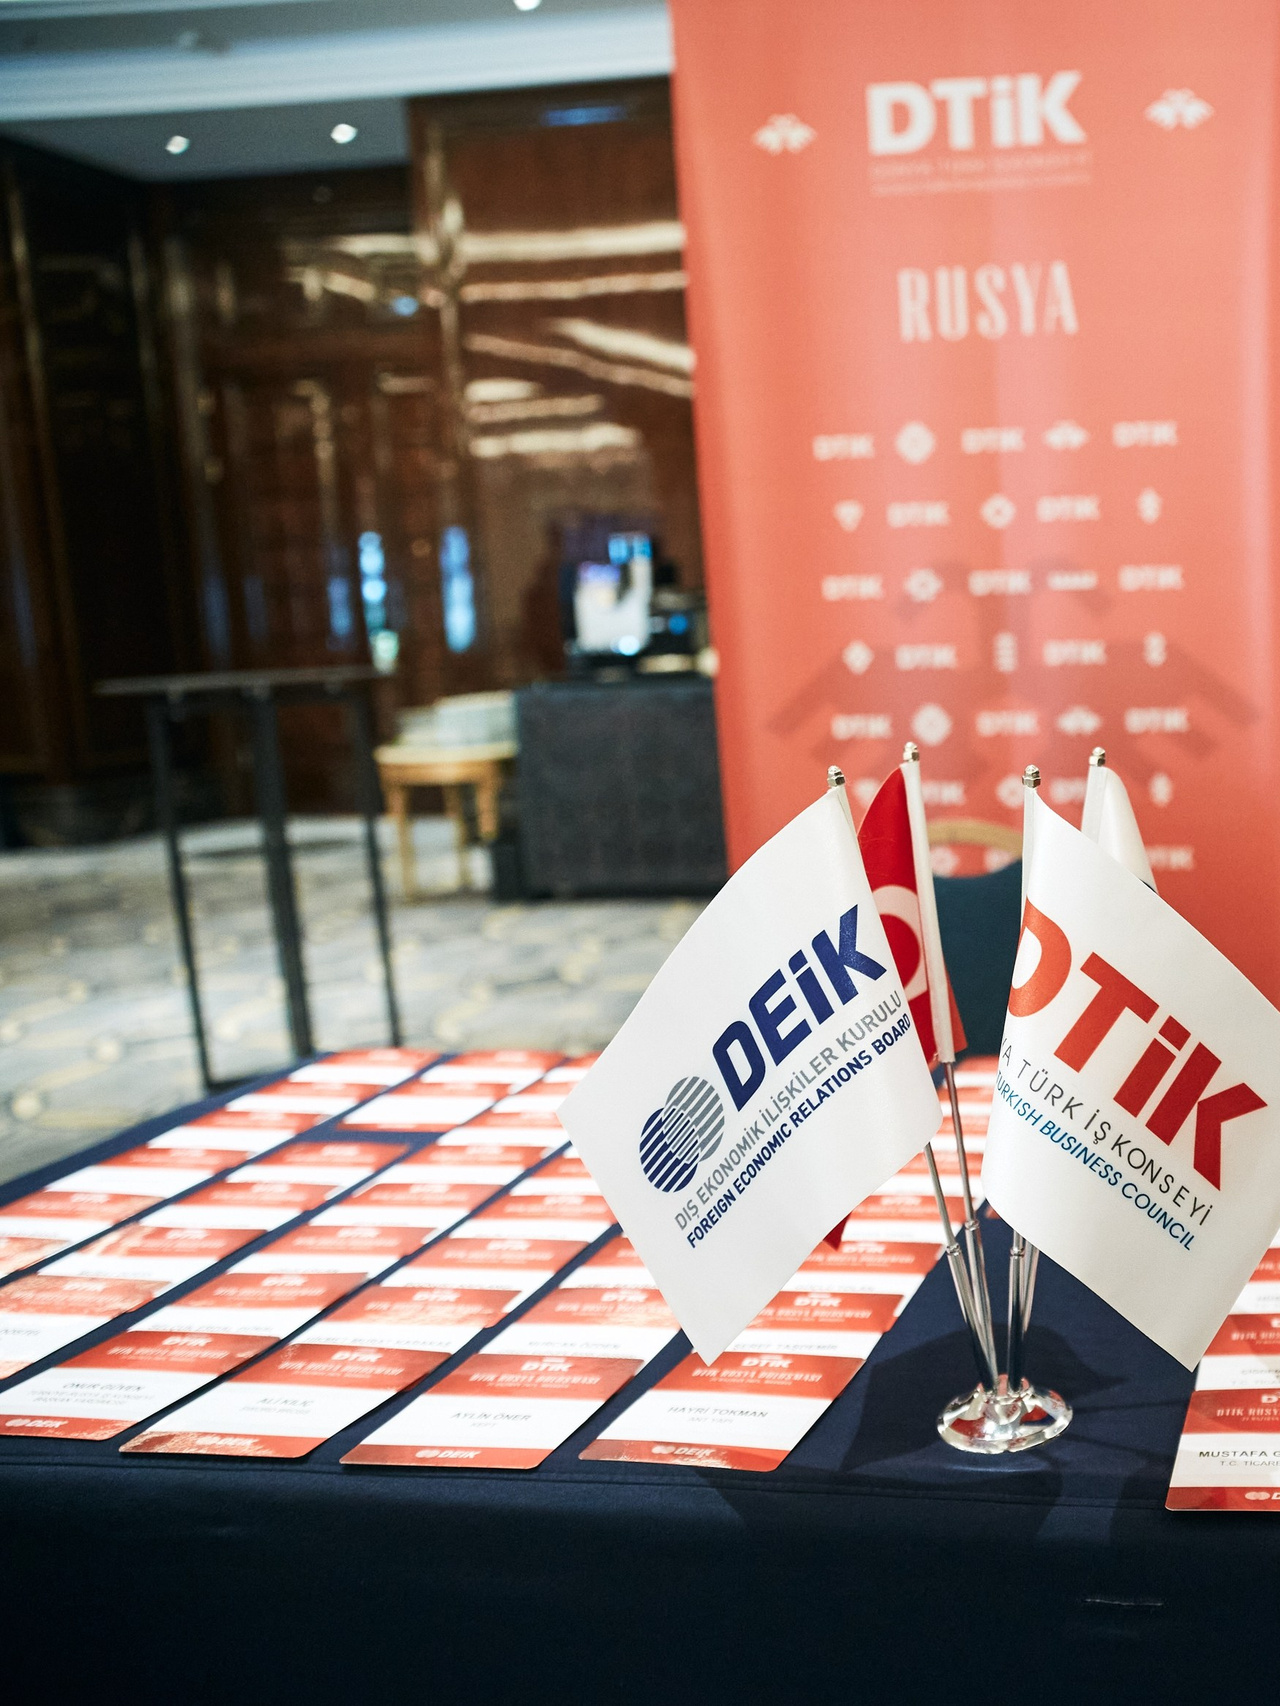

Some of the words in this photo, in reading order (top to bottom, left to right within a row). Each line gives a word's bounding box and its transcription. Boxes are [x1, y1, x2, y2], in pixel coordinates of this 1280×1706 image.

[897, 260, 1078, 343] RUSYA
[674, 1199, 699, 1231] DIŞ
[698, 1124, 766, 1206] EKONOMİK
[761, 1046, 839, 1131] İLİŞKİLER
[836, 990, 902, 1056] KURULU
[686, 1188, 737, 1249] FOREIGN
[733, 1121, 793, 1194] ECONOMIC
[789, 1048, 872, 1128] RELATIONS
[870, 1012, 911, 1058] BOARD
[1017, 1058, 1084, 1120] TÜRK
[1083, 1109, 1112, 1145] İŞ
[1110, 1133, 1214, 1227] KONSEYİ
[1039, 1119, 1123, 1187] BUSINESS
[1121, 1182, 1197, 1251] COUNCIL
[709, 1408, 770, 1418] TOKMAN
[1197, 1450, 1268, 1458] MUSTAFA
